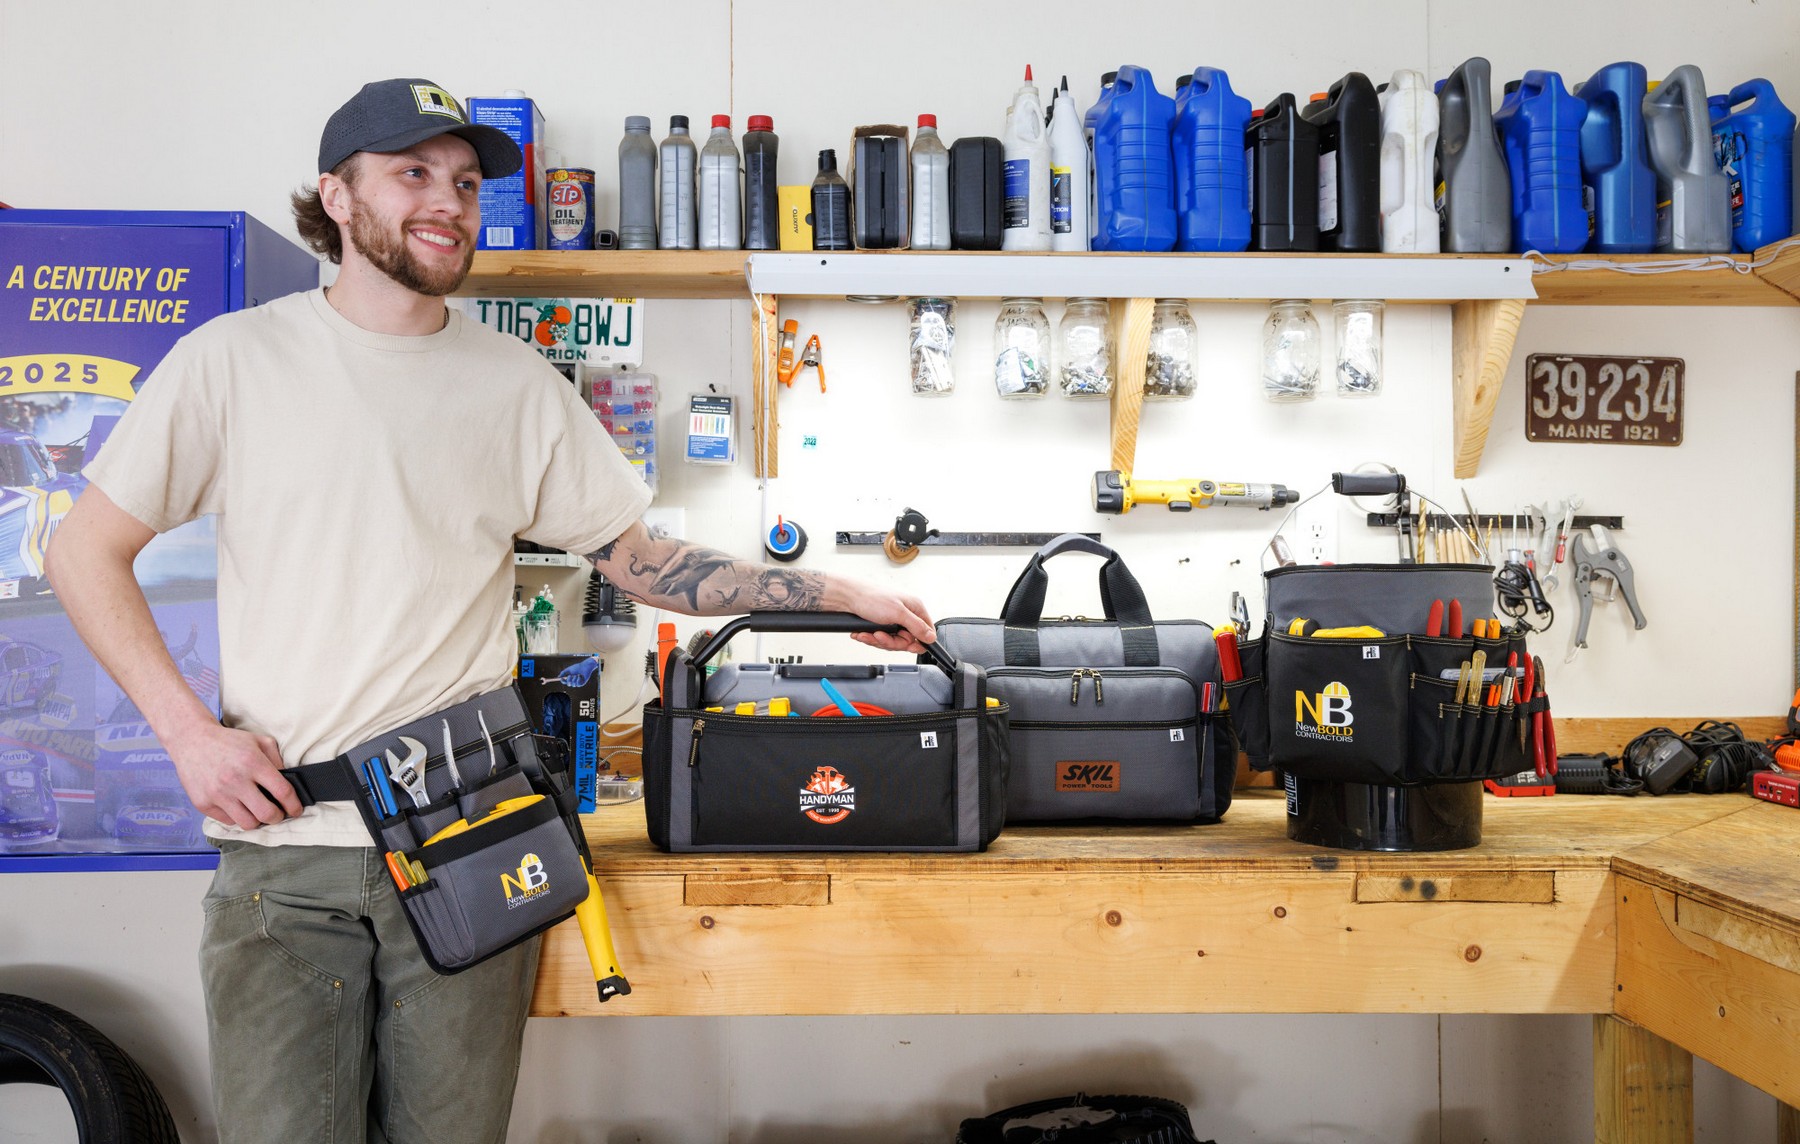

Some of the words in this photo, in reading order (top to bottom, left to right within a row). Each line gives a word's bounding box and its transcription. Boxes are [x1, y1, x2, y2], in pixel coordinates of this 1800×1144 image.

[553, 185, 578, 203] STP
[550, 219, 584, 227] TREATMENT
[555, 209, 576, 219] OIL
[7, 265, 25, 289] A
[33, 265, 151, 291] CENTURY
[156, 267, 190, 292] OF
[29, 297, 189, 324] EXCELLENCE
[575, 304, 632, 346] 8WJ
[0, 362, 99, 387] 2025
[1548, 423, 1613, 440] MAINE
[1624, 424, 1659, 441] 1921
[522, 663, 530, 674] XL
[580, 700, 590, 717] 50
[1295, 721, 1354, 737] NewBOLD
[1295, 730, 1354, 743] CONTRACTORS
[585, 725, 595, 769] NITRILE
[1063, 764, 1114, 786] SKIL
[799, 793, 855, 805] HANDYMAN
[136, 811, 175, 822] NAPA
[507, 889, 551, 910] CONTRACTORS
